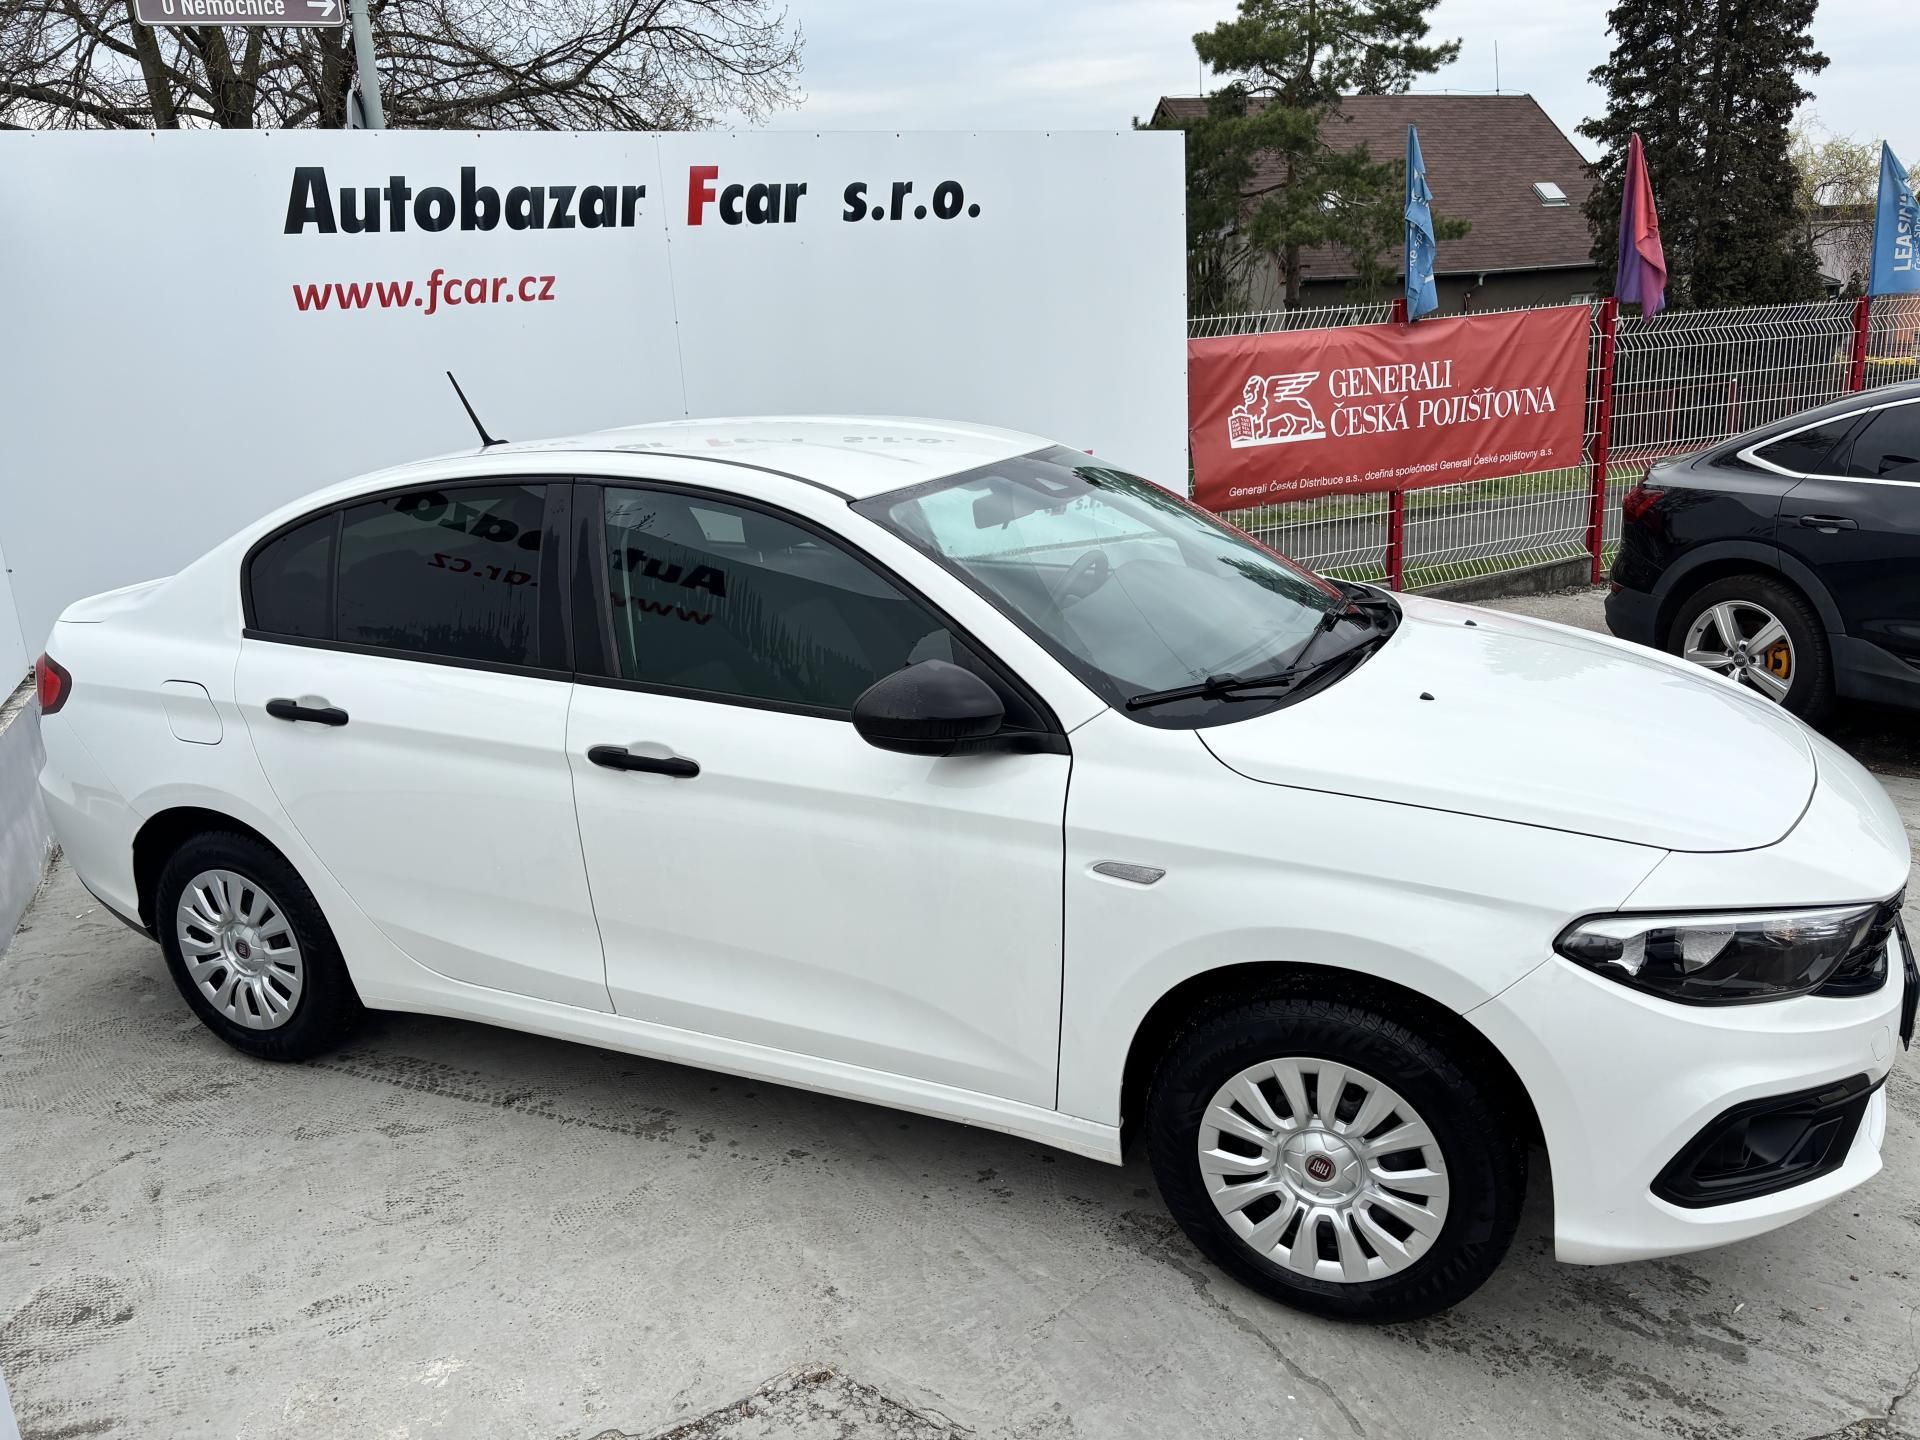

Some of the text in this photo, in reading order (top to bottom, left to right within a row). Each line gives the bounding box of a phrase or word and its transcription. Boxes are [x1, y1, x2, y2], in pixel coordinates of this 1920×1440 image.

[181, 0, 286, 16] Nemocnice
[284, 166, 981, 234] Autobazar Fcar s.r.o.
[292, 268, 556, 315] www.fcar.cz
[1328, 359, 1453, 399] GENERALI
[1330, 385, 1556, 437] ČESKÁ POJIŠŤOVNA
[1228, 486, 1267, 497] Generali
[1269, 479, 1298, 492] Česká
[1300, 475, 1344, 489] Distribuce
[1395, 462, 1438, 478] společnost
[1440, 457, 1472, 470] Generali
[1473, 453, 1498, 466] České
[1499, 450, 1539, 466] pojišťovny
[1540, 447, 1554, 457] a.s.
[1310, 1159, 1330, 1176] FIAT
